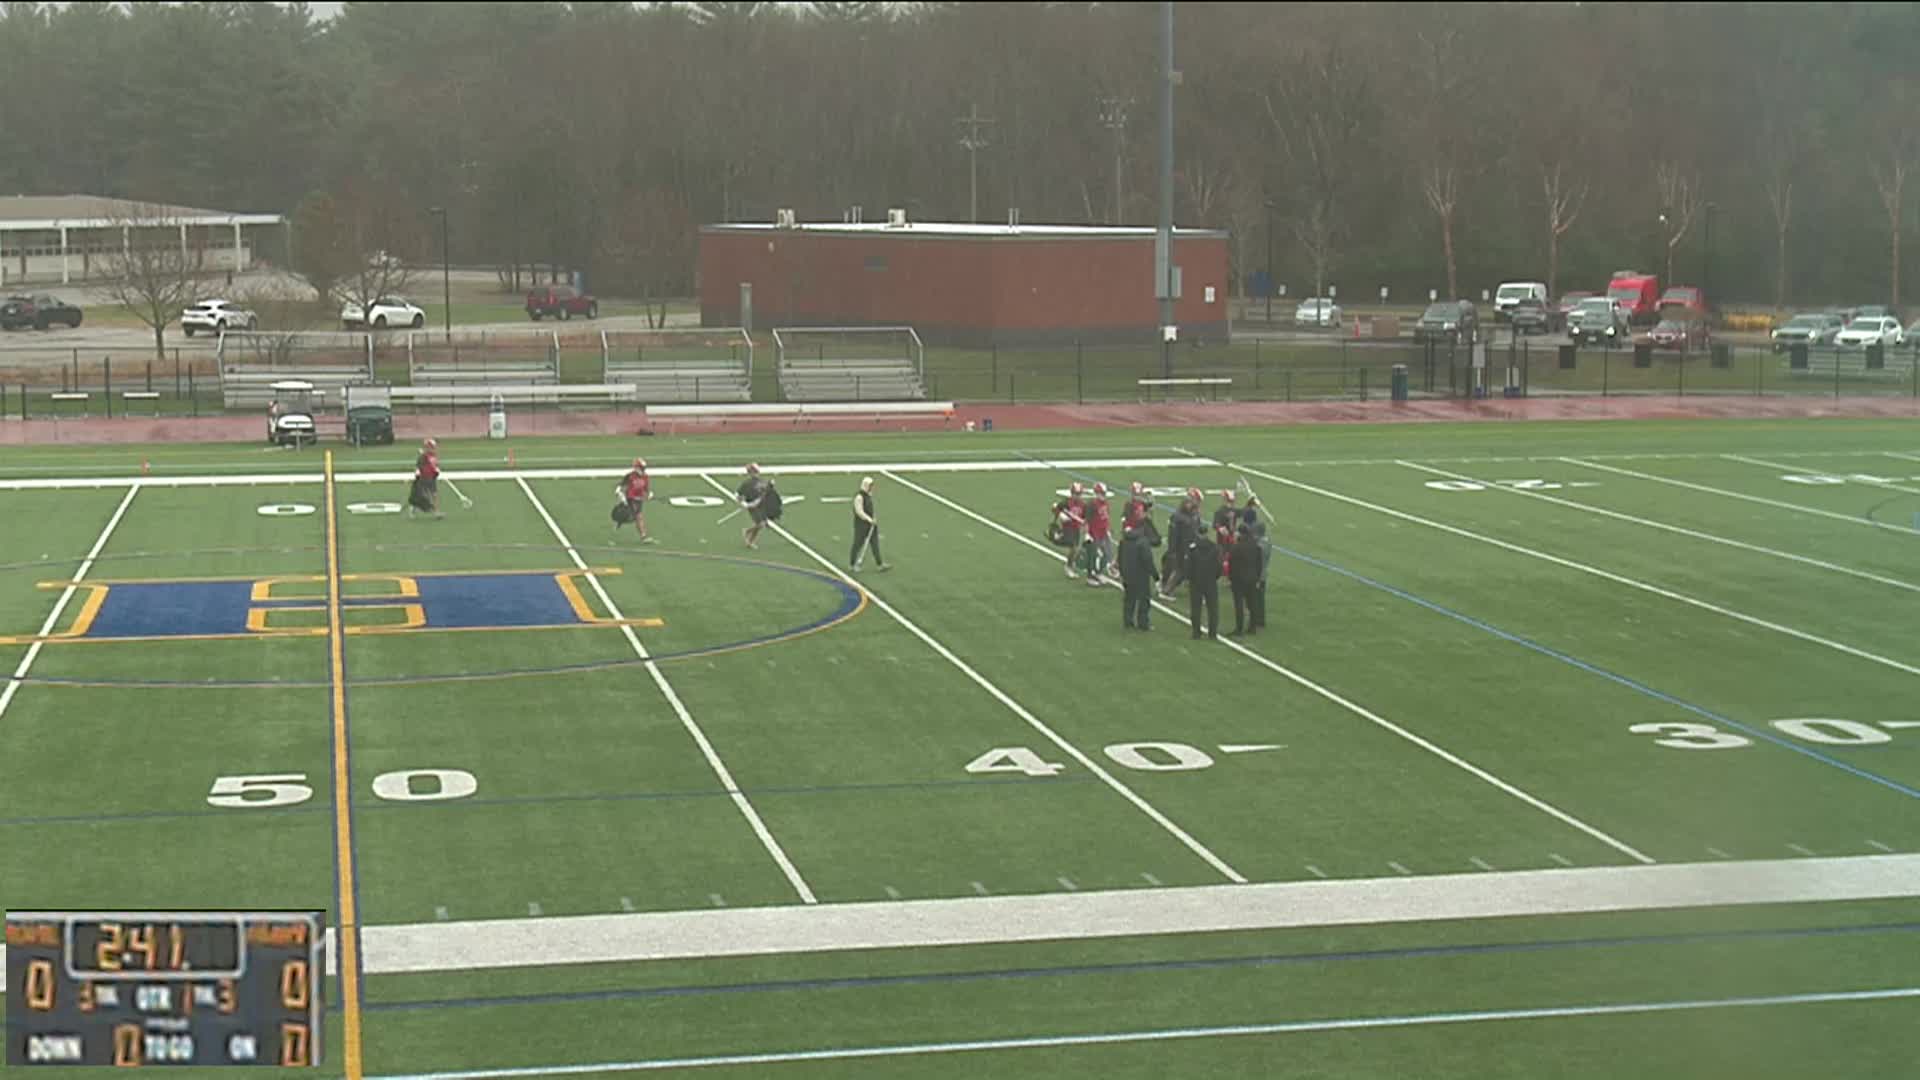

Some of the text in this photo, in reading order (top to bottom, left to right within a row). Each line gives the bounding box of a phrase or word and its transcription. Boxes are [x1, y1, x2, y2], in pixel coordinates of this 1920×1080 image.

[1628, 718, 1893, 748] 30
[965, 742, 1214, 776] 40
[207, 768, 477, 808] 50
